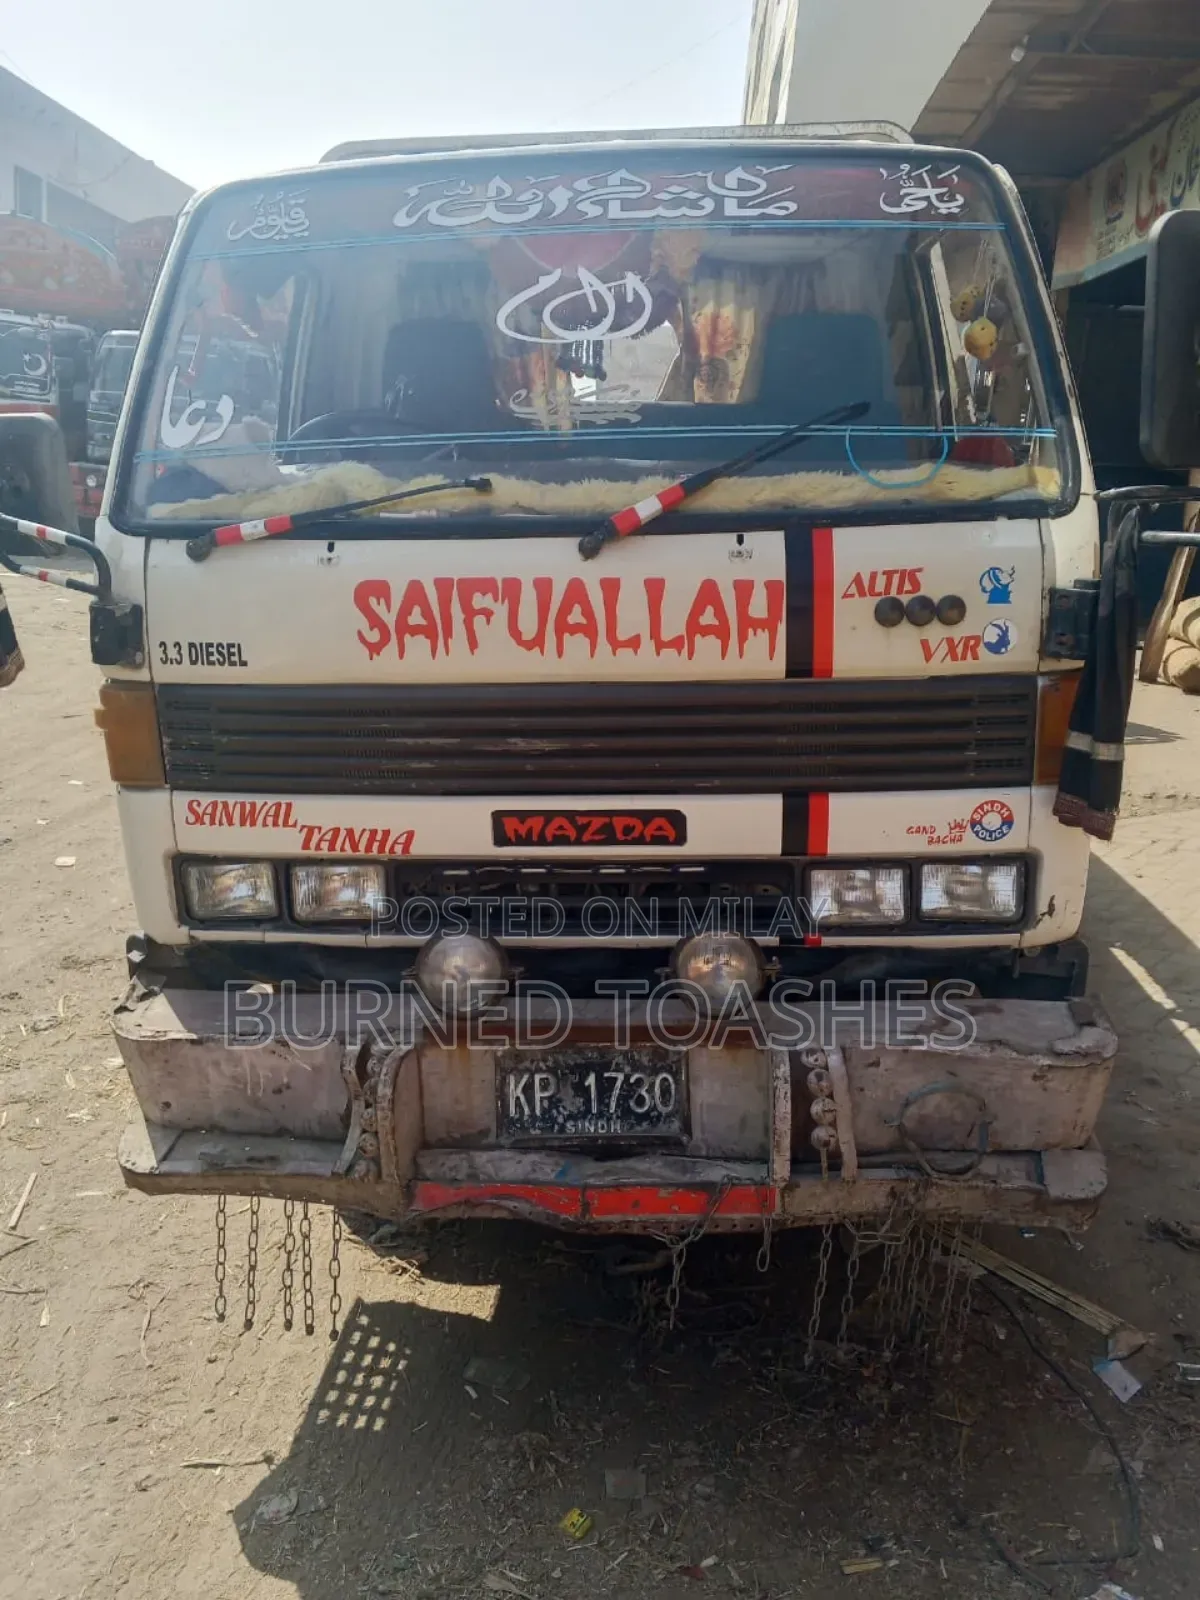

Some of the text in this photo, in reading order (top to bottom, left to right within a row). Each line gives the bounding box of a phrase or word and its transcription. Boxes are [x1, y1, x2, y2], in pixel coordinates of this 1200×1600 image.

[841, 567, 924, 599] ALTIS
[353, 576, 785, 661] SAIFUALLAH
[158, 640, 249, 667] 3.3 DIESEL
[920, 634, 982, 664] VXR
[185, 799, 298, 828] SANWAL
[972, 802, 1011, 821] SINDH
[298, 824, 415, 855] TANHA
[502, 815, 676, 842] MAZDA
[973, 823, 1009, 841] POLICE
[508, 1071, 676, 1118] KP 1730
